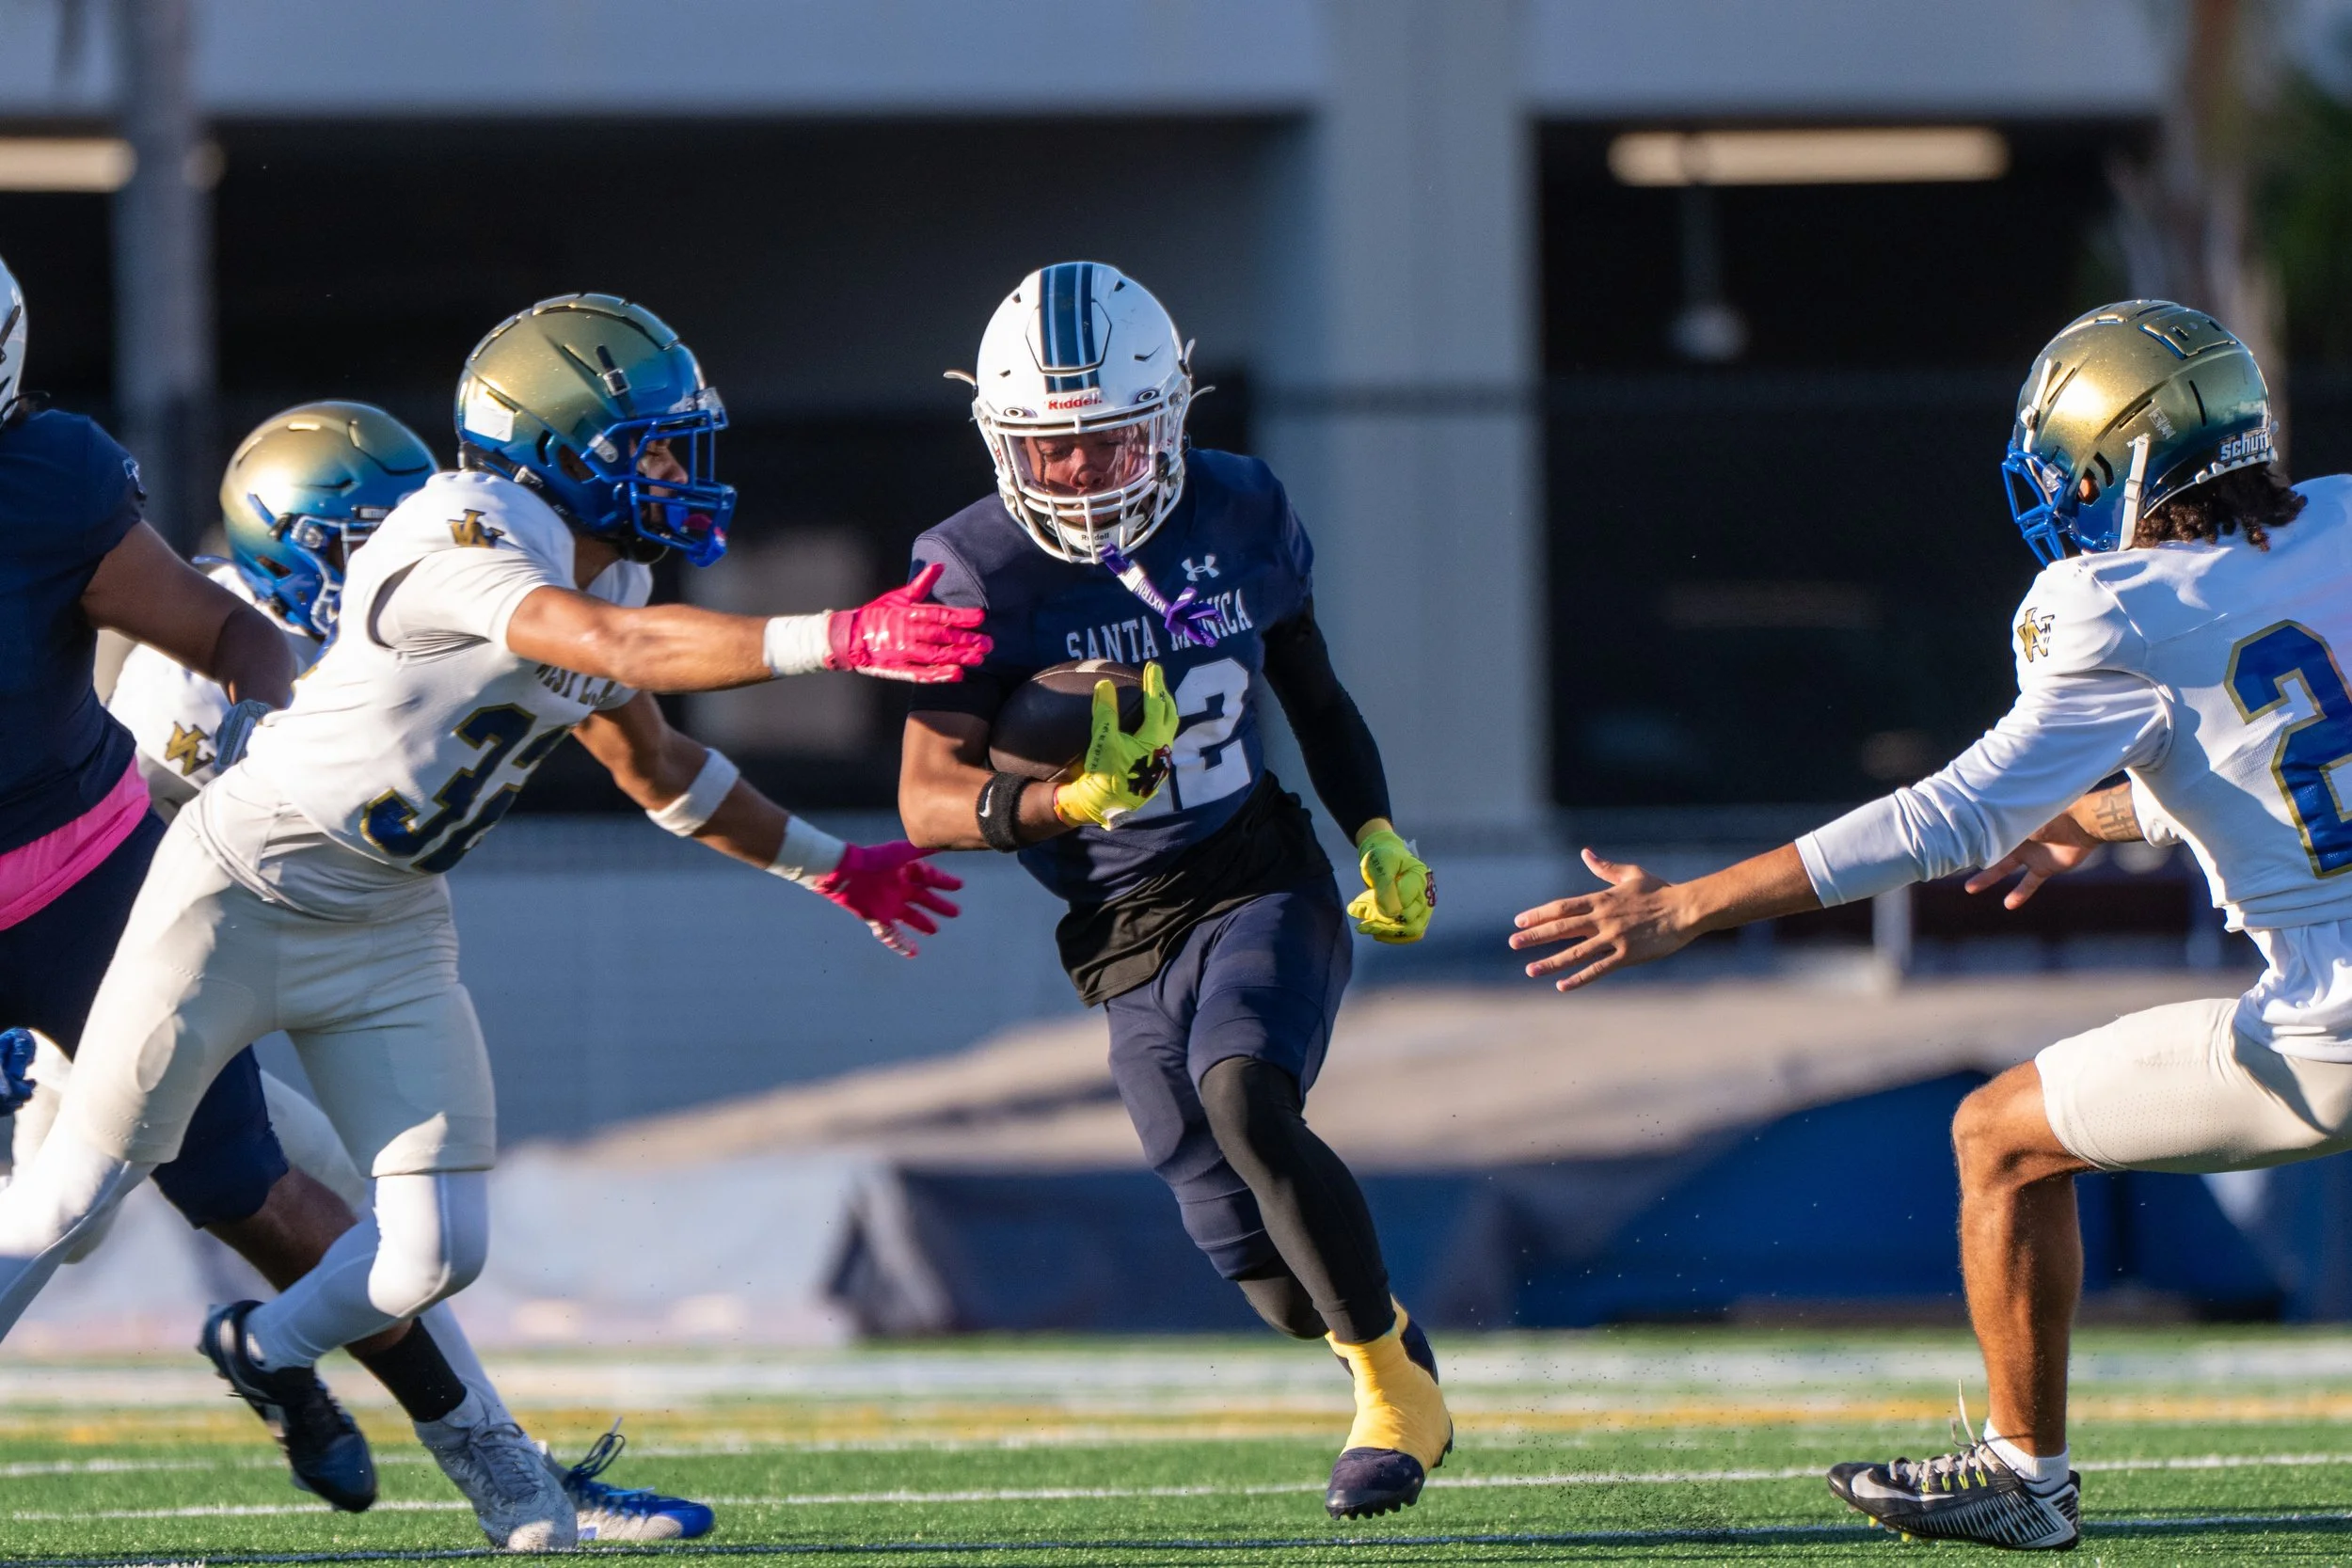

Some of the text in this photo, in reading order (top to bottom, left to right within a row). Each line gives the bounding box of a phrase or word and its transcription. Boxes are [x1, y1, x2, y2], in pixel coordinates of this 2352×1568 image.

[1081, 532, 1109, 541] Ridell
[1066, 588, 1253, 664] SANTA MNICA
[1113, 657, 1251, 824] 2
[2223, 619, 2352, 879] 2
